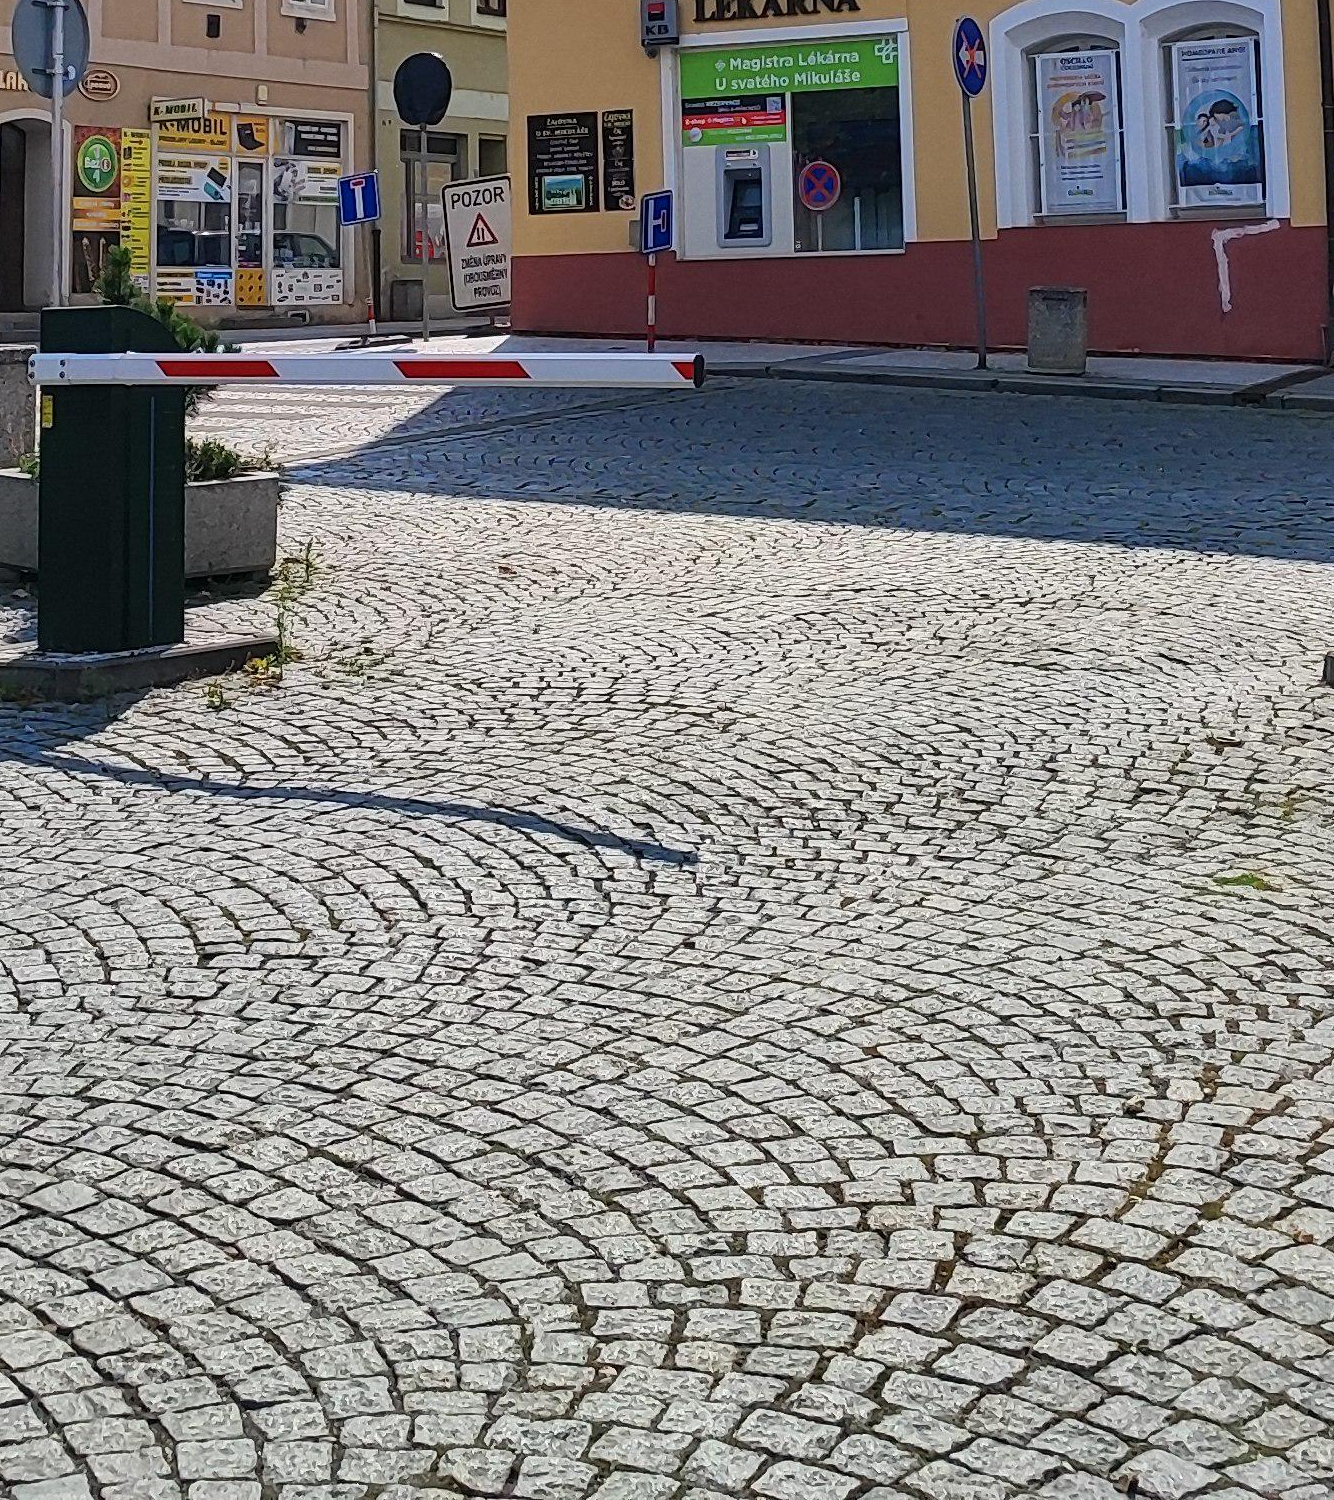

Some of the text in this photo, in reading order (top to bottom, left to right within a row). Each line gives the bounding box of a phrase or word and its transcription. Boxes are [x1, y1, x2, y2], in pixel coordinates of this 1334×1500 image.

[645, 24, 670, 36] KB
[729, 50, 860, 73] Magistra Lékárna
[715, 68, 861, 91] U svatého Mikuláše
[450, 186, 505, 210] POZOR
